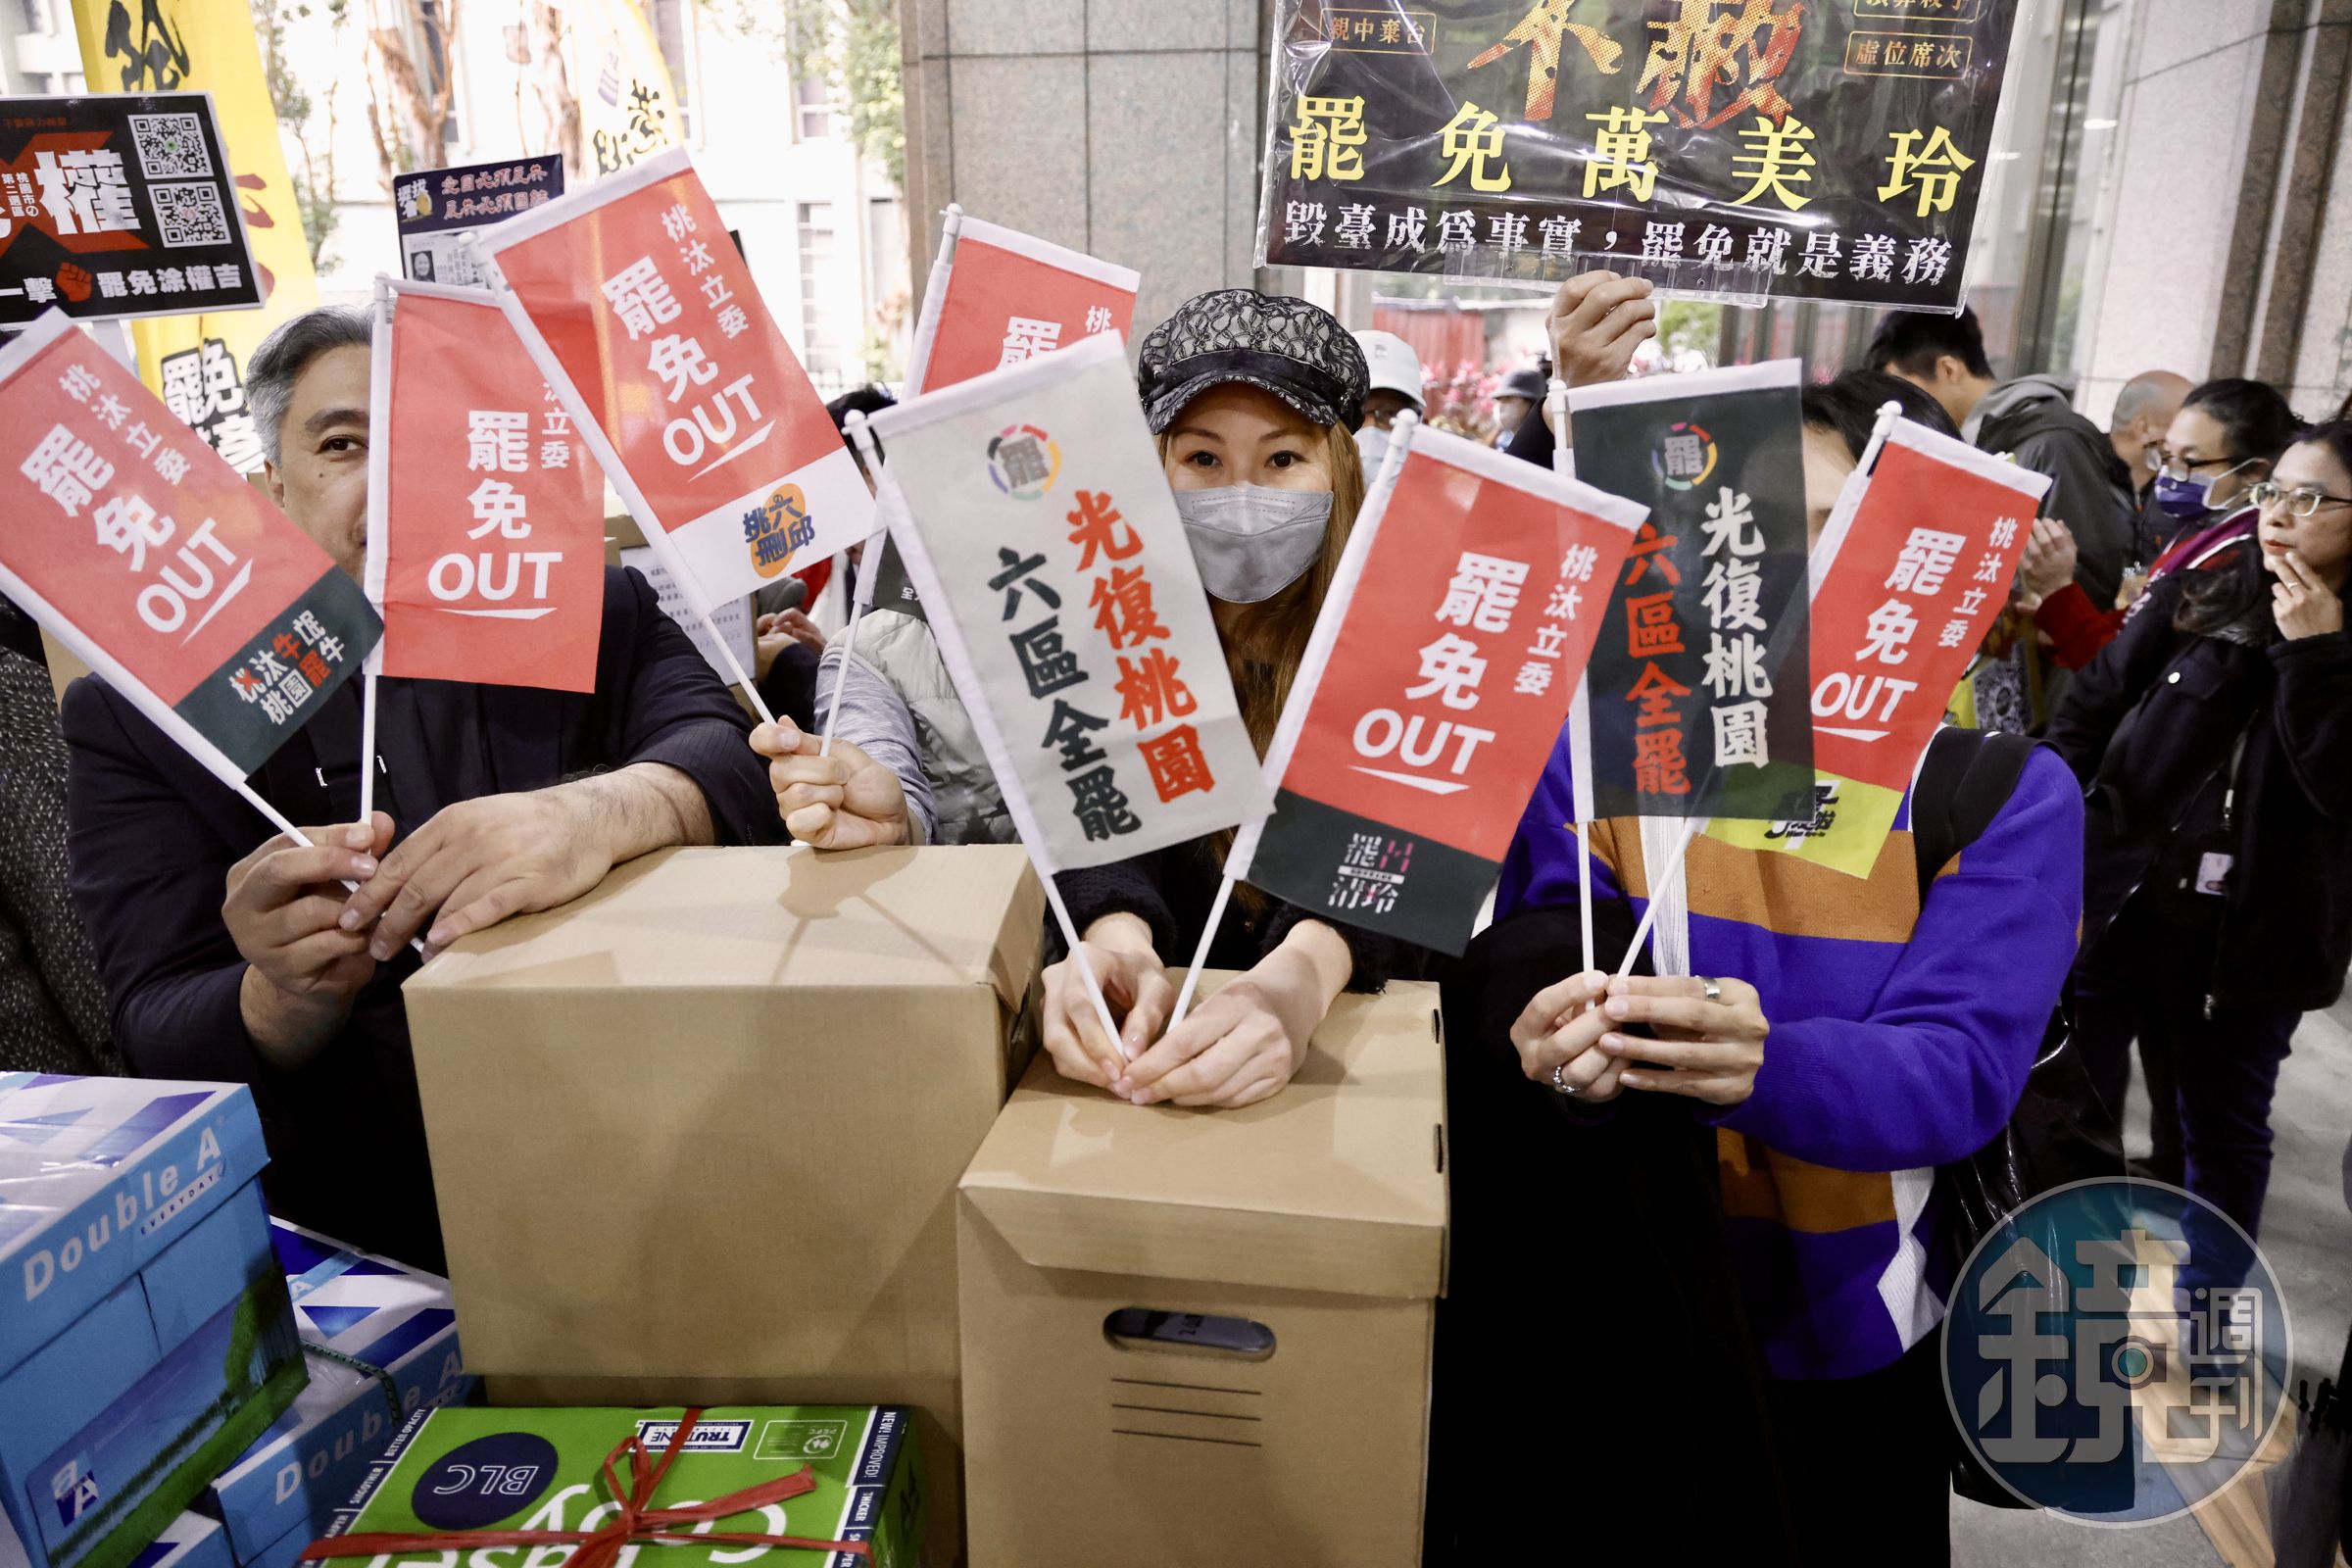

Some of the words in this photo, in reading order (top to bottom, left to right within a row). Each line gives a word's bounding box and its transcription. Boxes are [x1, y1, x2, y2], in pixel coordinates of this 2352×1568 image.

[1289, 95, 1976, 218] 罷免萬美玲
[96, 264, 242, 298] 罷免涂權吉
[600, 256, 718, 404] 罷免
[661, 205, 751, 340] 桃汰立委
[58, 364, 191, 486] 桃汰立委
[466, 410, 532, 540] 罷免
[662, 373, 764, 466] OUT
[20, 423, 176, 572] 罷免
[136, 517, 237, 633] OUT
[427, 552, 563, 601] OUT
[1404, 552, 1531, 711] 罷免
[1513, 543, 1598, 696] 桃汰立委
[1700, 486, 1773, 769] 光復桃園
[1856, 527, 1967, 665] 罷免
[1938, 515, 2019, 649] 桃汰立委
[988, 546, 1143, 843] 六區全罷
[1065, 489, 1216, 804] 光復桃園
[1624, 522, 1692, 797] 六區全罷
[1812, 672, 1918, 723] OUT
[1352, 708, 1496, 775] OUT
[24, 1165, 178, 1301] Double
[197, 1126, 221, 1171] A
[140, 1174, 214, 1236] EVERYDAY
[275, 1386, 420, 1505] Doube
[433, 1465, 539, 1496] BLC
[855, 1492, 873, 1522] THICKER
